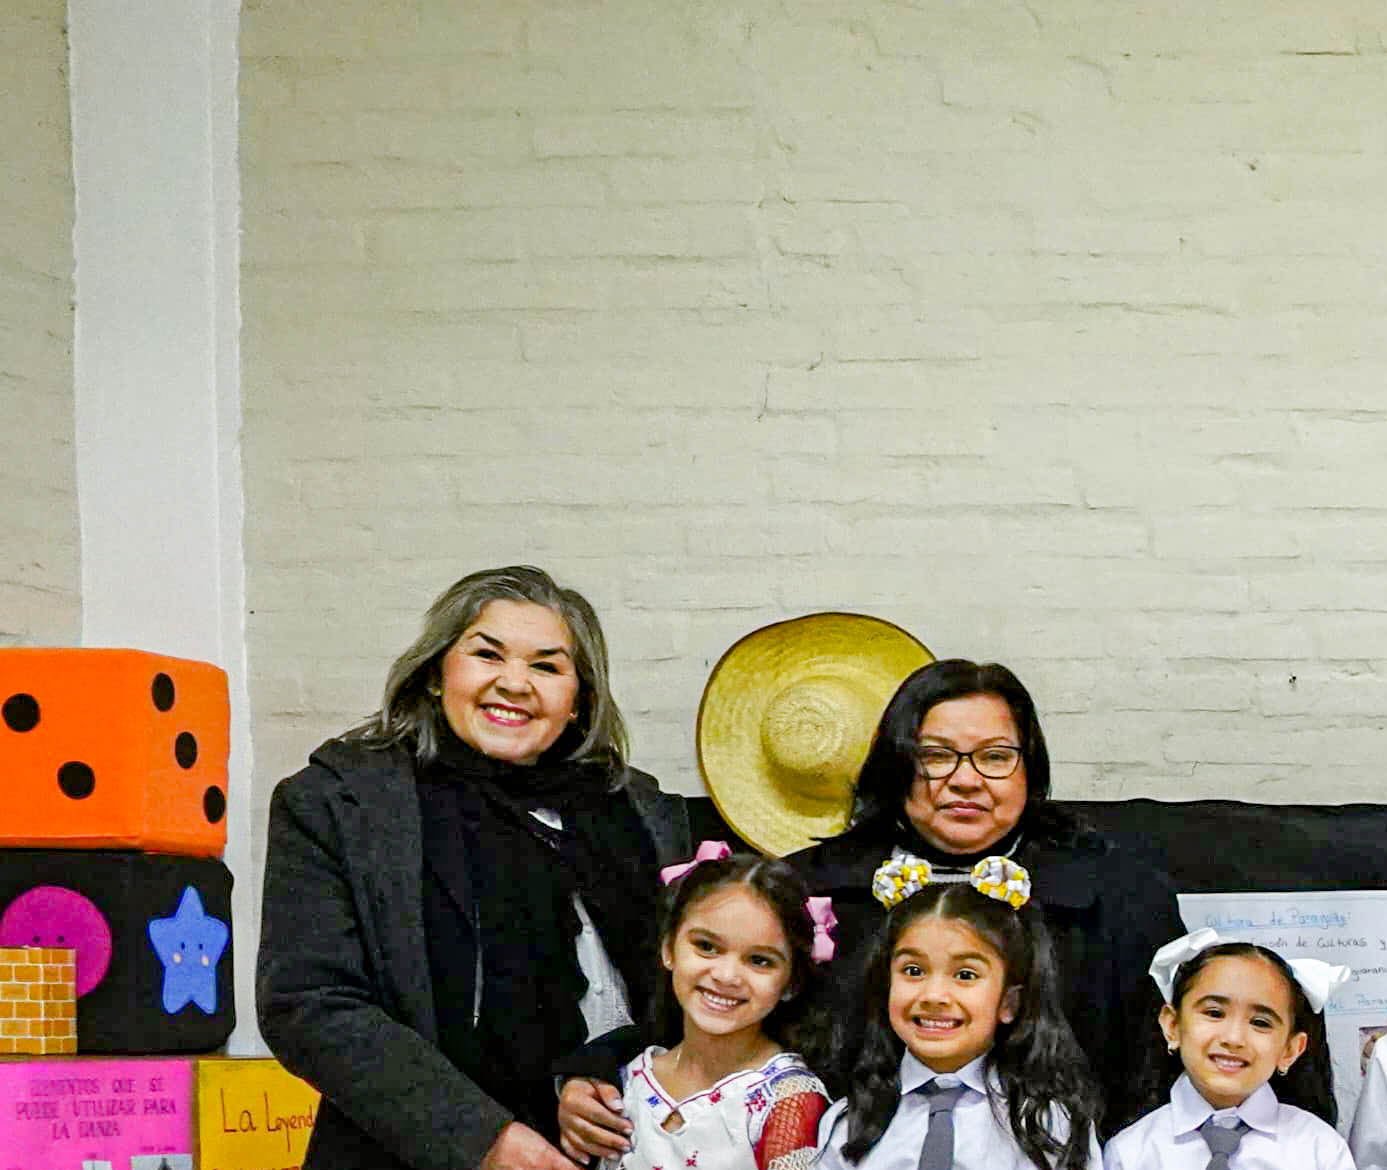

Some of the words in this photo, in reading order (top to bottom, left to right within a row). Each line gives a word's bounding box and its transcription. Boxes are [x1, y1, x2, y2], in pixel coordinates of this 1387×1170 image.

[143, 1098, 177, 1115] PARA
[220, 1088, 257, 1133] La
[264, 1090, 316, 1153] Leyend
[52, 1121, 71, 1140] LA
